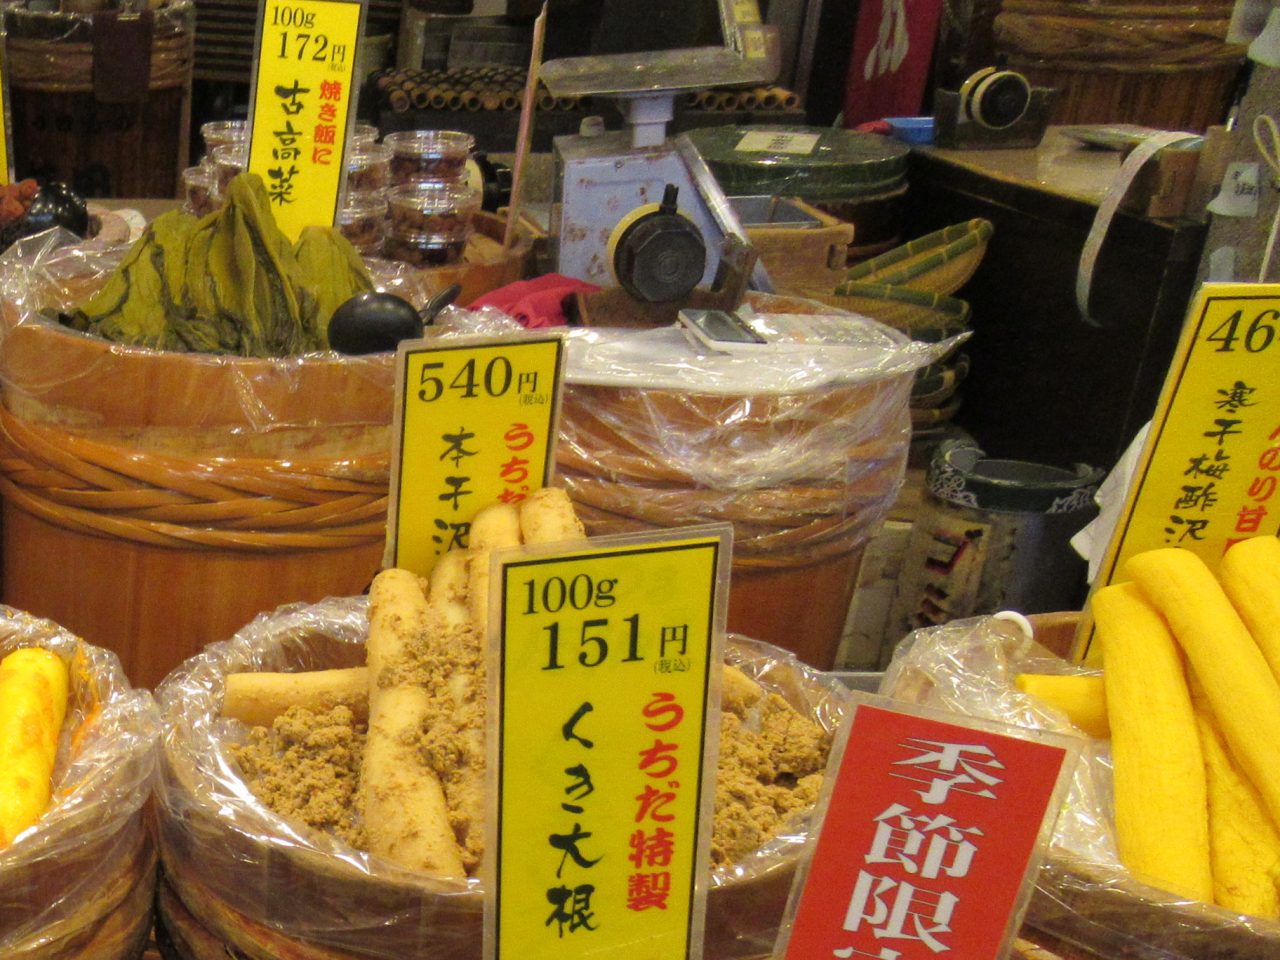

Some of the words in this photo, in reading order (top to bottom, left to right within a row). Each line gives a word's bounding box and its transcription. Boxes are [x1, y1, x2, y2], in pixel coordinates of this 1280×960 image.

[271, 6, 316, 29] 100g
[277, 32, 347, 63] 172円
[312, 79, 343, 166] 焼き飯に
[418, 356, 538, 402] 540円
[521, 573, 619, 615] 100g
[541, 614, 689, 671] 151円
[545, 701, 603, 938] くき大根
[626, 692, 685, 911] うちだ特製
